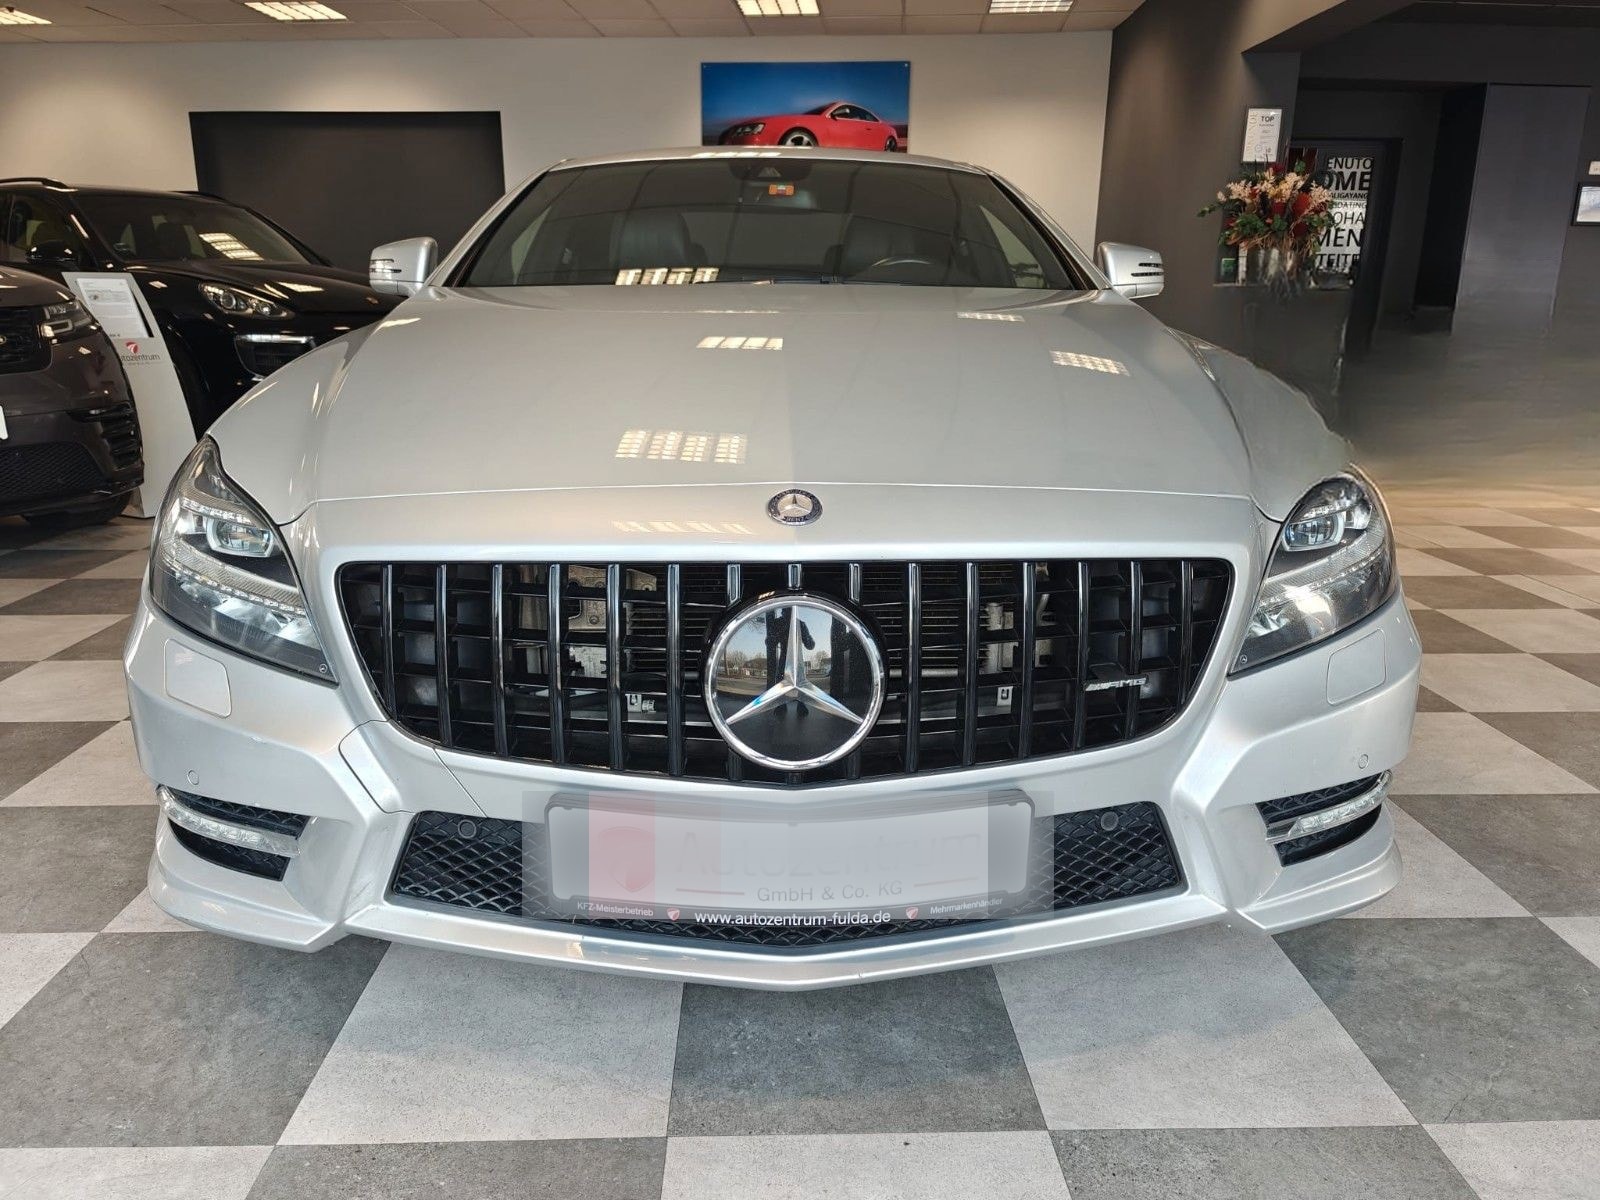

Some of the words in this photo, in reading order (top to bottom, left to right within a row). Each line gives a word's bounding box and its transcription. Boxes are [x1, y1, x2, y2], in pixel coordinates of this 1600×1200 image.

[757, 887, 813, 902] GmbH
[821, 886, 835, 900] &
[842, 884, 869, 899] Co.
[878, 880, 902, 896] KG
[577, 901, 654, 917] KFZ-Meisterbetrieb
[694, 910, 892, 926] www.autozentrum-fulda.de
[930, 898, 1003, 914] Mehrmarkenhändler
